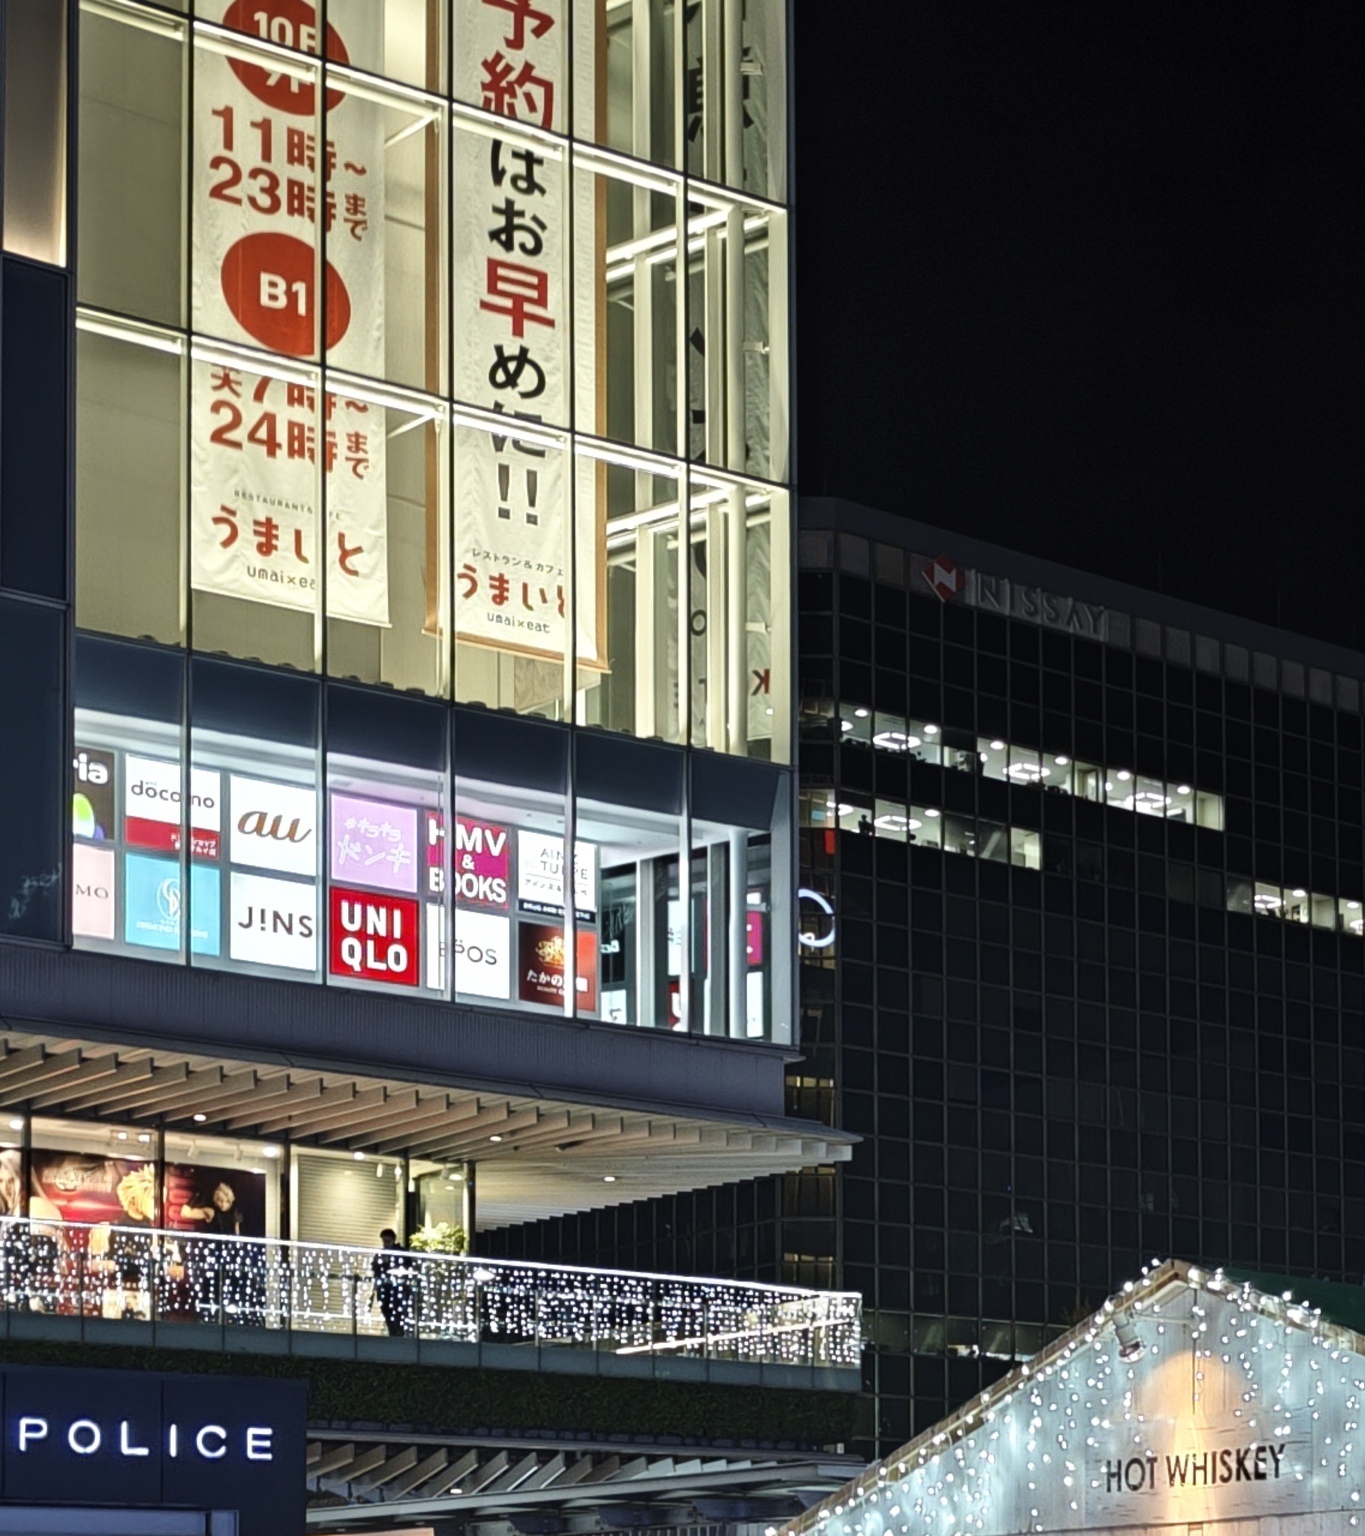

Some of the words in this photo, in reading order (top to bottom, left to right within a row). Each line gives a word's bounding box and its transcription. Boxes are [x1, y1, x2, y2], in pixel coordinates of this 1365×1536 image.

[260, 271, 307, 317] B1
[976, 571, 1104, 634] NISSAY
[237, 810, 312, 844] au
[428, 818, 507, 857] HMV
[461, 854, 475, 871] &
[428, 867, 507, 903] BOKS
[341, 900, 402, 939] UNI
[341, 936, 408, 973] QLO
[527, 969, 588, 993] たかの
[18, 1417, 274, 1461] POLICE
[1105, 1455, 1158, 1493] HOT
[1166, 1443, 1287, 1487] WHISKEY
